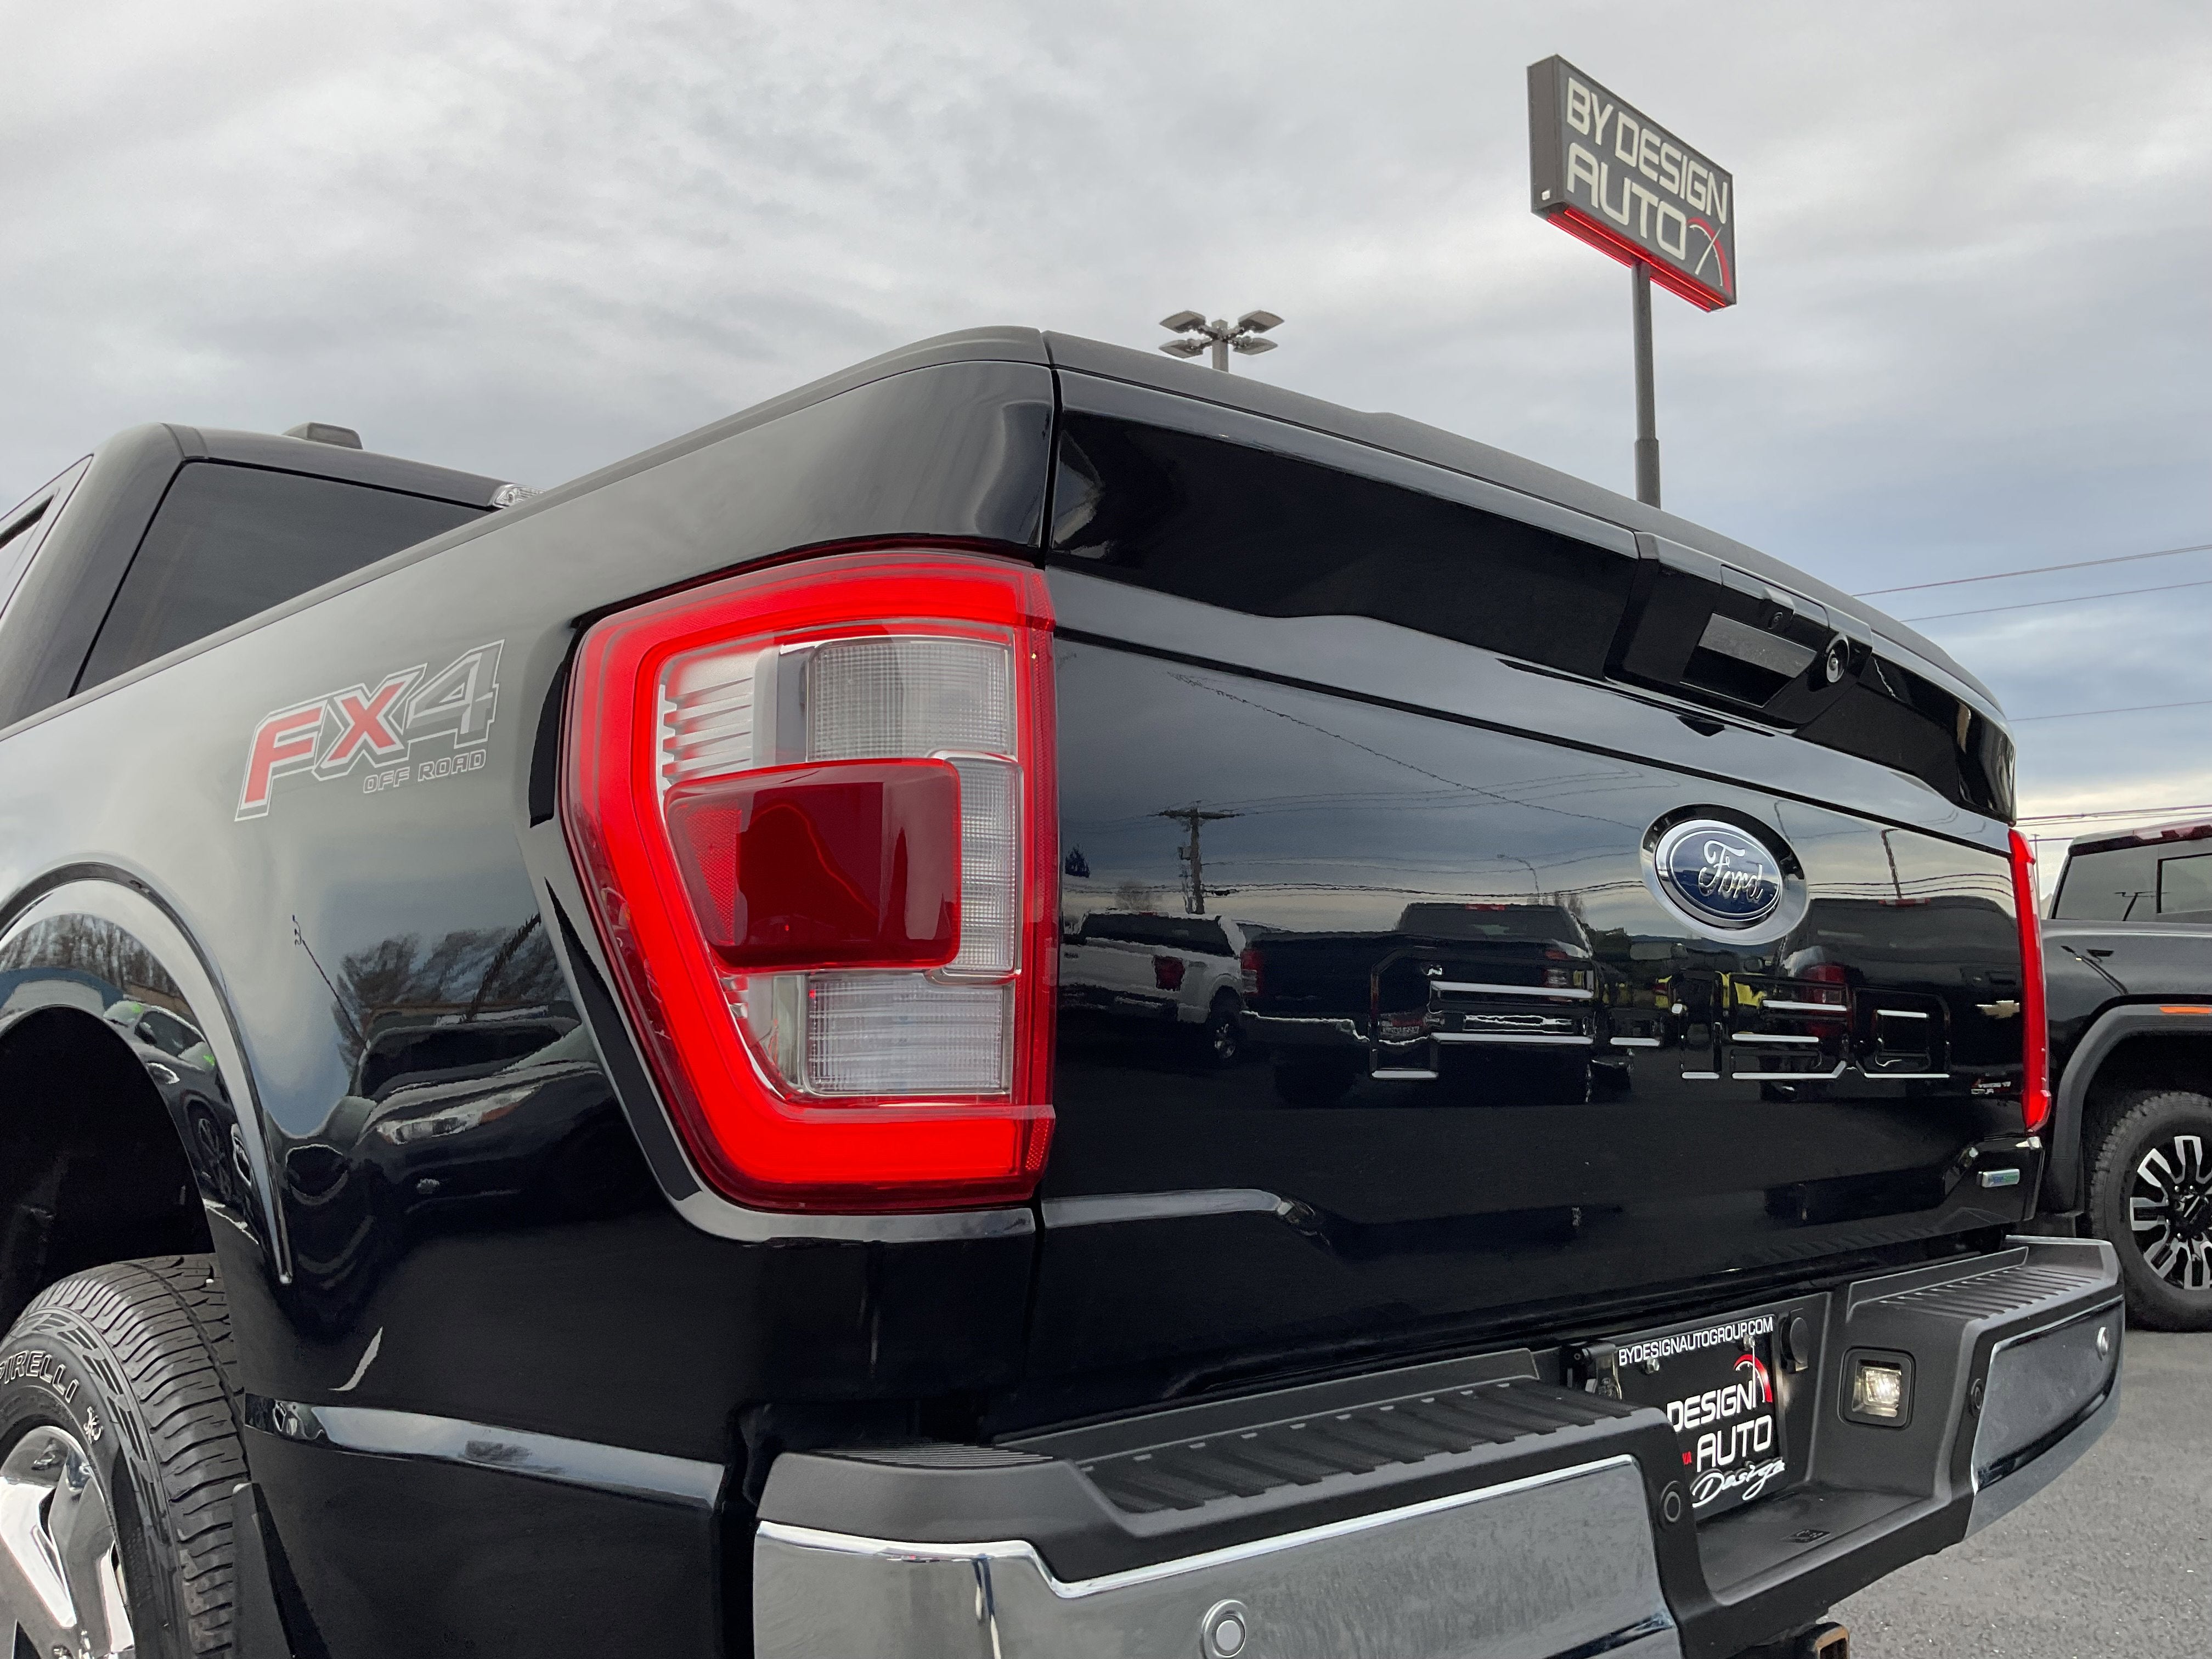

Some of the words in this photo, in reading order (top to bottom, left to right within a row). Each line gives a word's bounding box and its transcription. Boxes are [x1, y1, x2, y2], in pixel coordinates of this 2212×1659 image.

[1567, 77, 1613, 145] BY
[1615, 111, 1728, 224] DESIGN
[1567, 142, 1686, 260] AUTO
[235, 639, 505, 822] FX4
[363, 767, 410, 794] OFF
[417, 749, 487, 782] ROAD
[1699, 839, 1763, 902] Ford
[1618, 1316, 1773, 1367] BYDESIGNAUTOGROUPCOM
[1667, 1380, 1753, 1432] DESIGN
[1696, 1414, 1773, 1472] AUTO
[1691, 1459, 1785, 1508] Design
